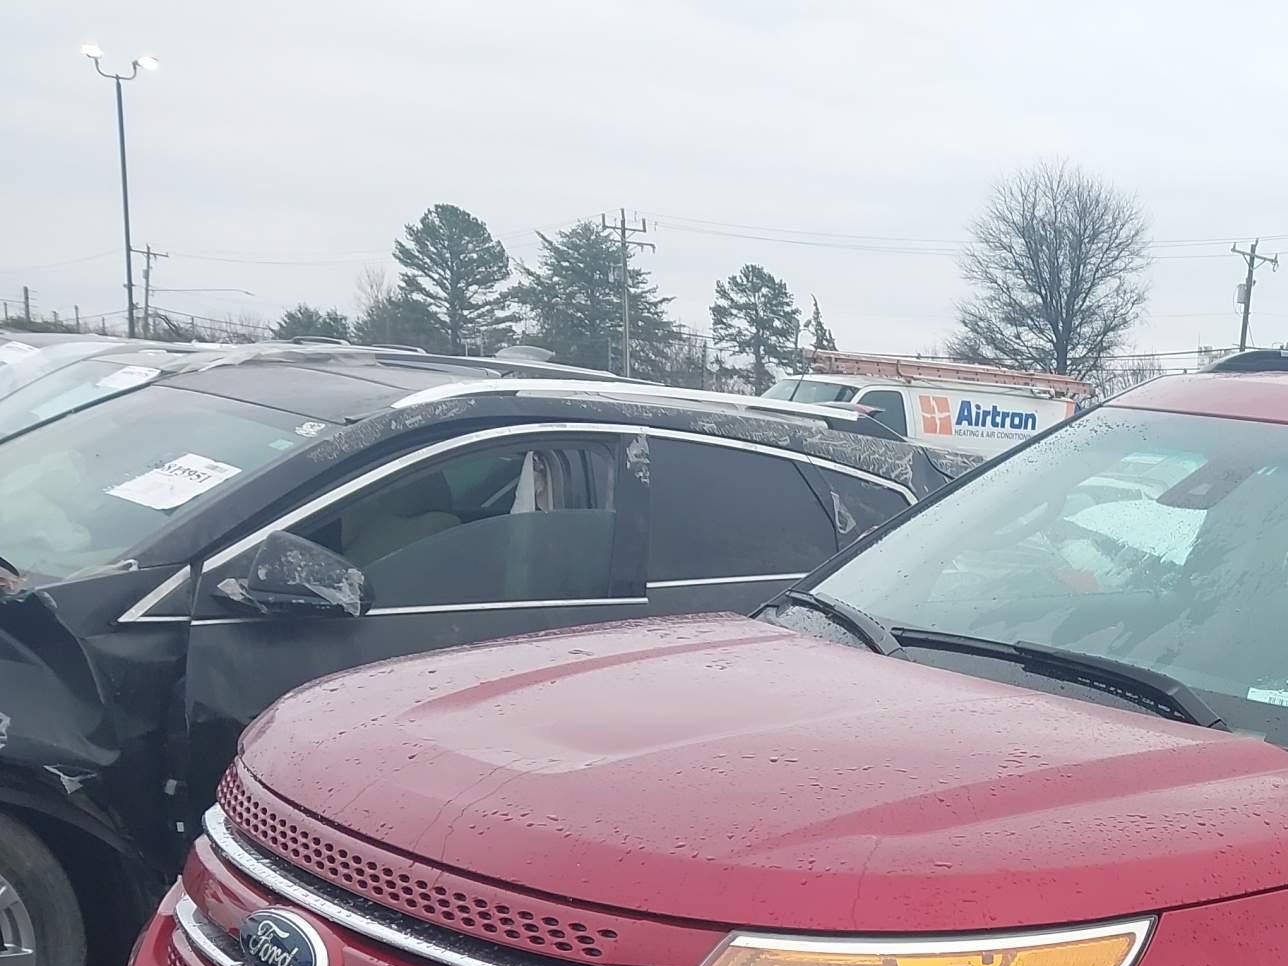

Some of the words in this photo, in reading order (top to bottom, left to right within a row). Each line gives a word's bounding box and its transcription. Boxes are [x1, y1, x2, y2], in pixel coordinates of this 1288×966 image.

[955, 399, 1037, 431] Airtron
[955, 429, 980, 438] HEATING
[986, 431, 996, 439] AIR
